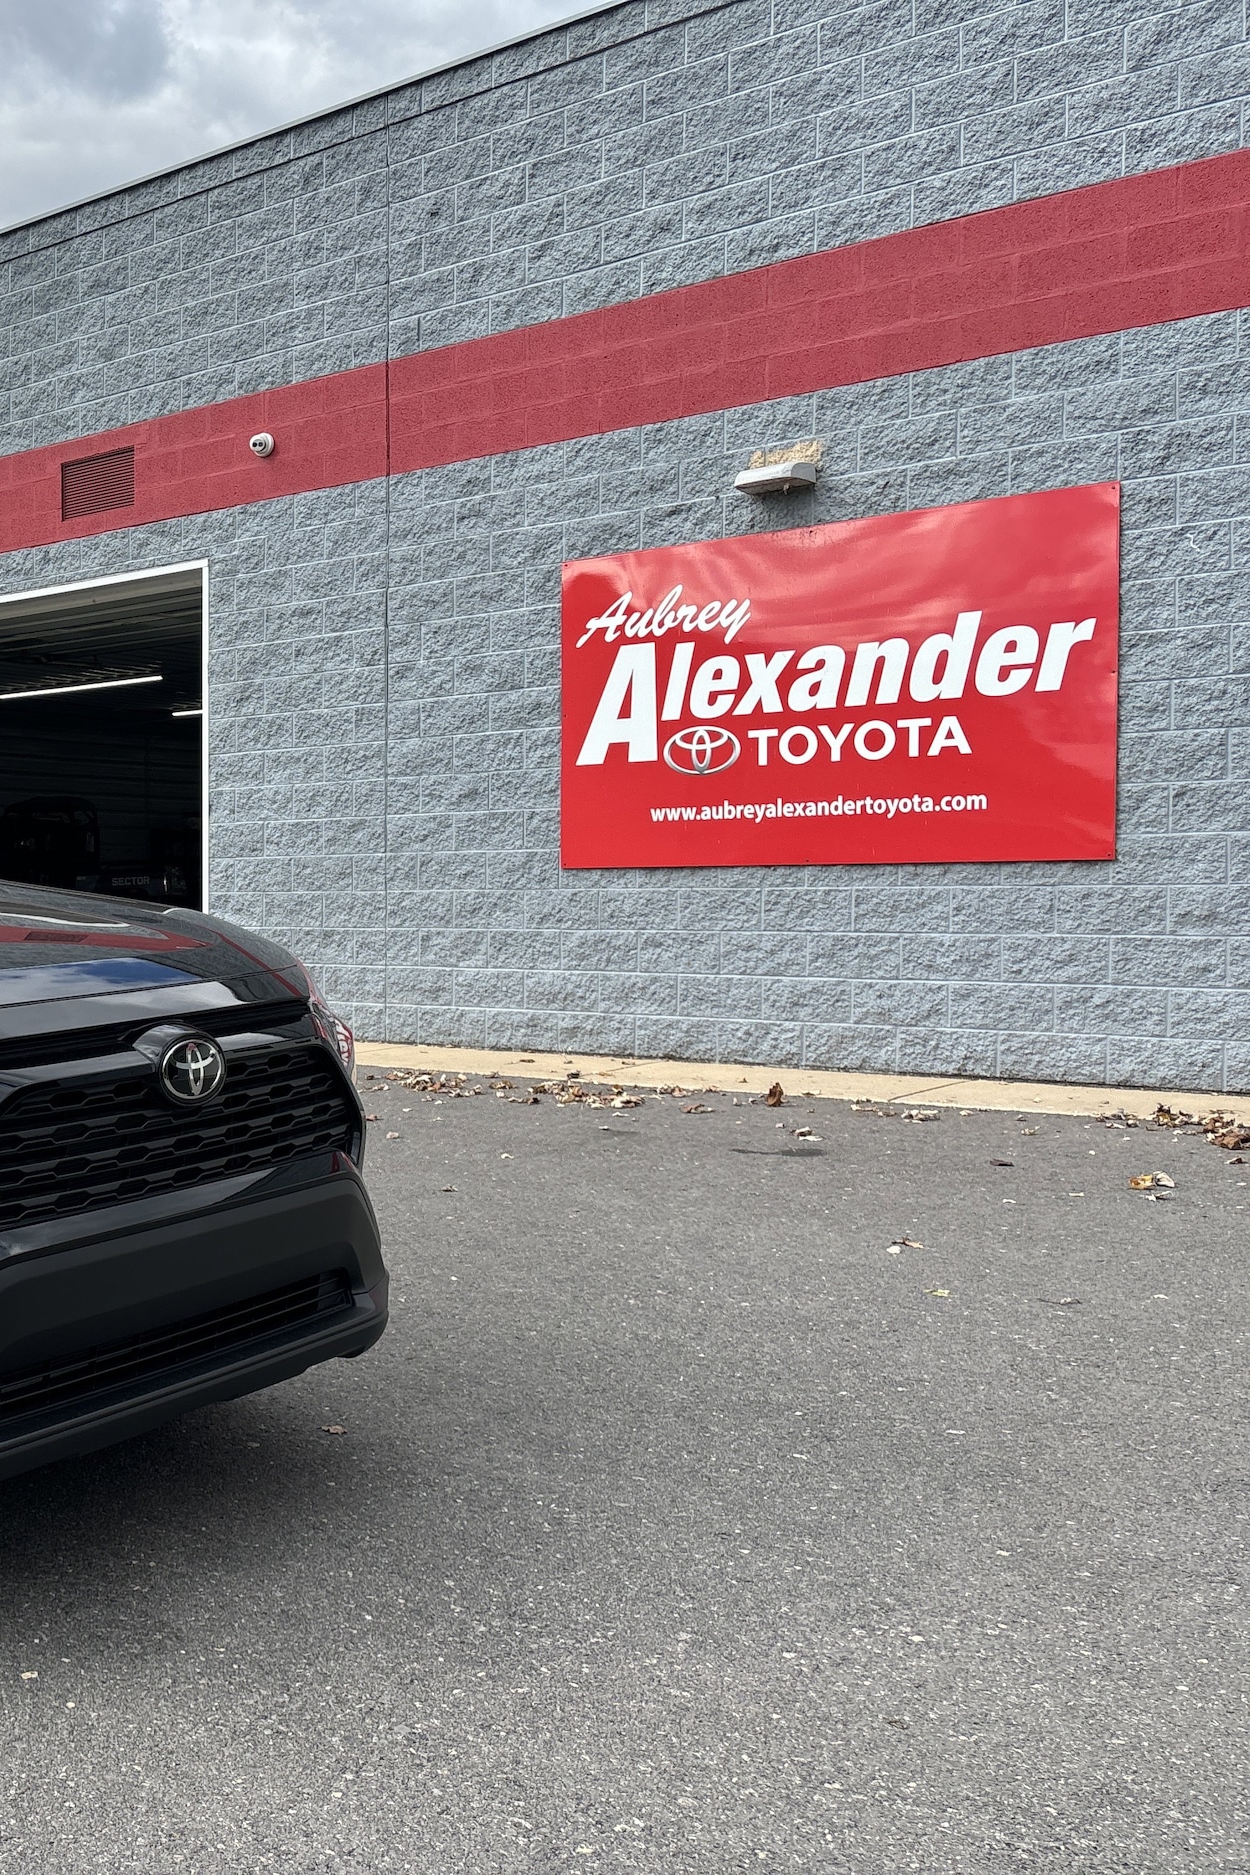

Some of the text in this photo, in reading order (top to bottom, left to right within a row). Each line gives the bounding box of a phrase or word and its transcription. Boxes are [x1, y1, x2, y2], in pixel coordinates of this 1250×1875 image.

[576, 584, 751, 649] Aubrey
[576, 611, 1096, 766] Alexander
[748, 716, 972, 766] TOYOTA
[650, 793, 987, 823] www.aubreyalexandertoyota.com
[111, 876, 150, 886] SECTOR
